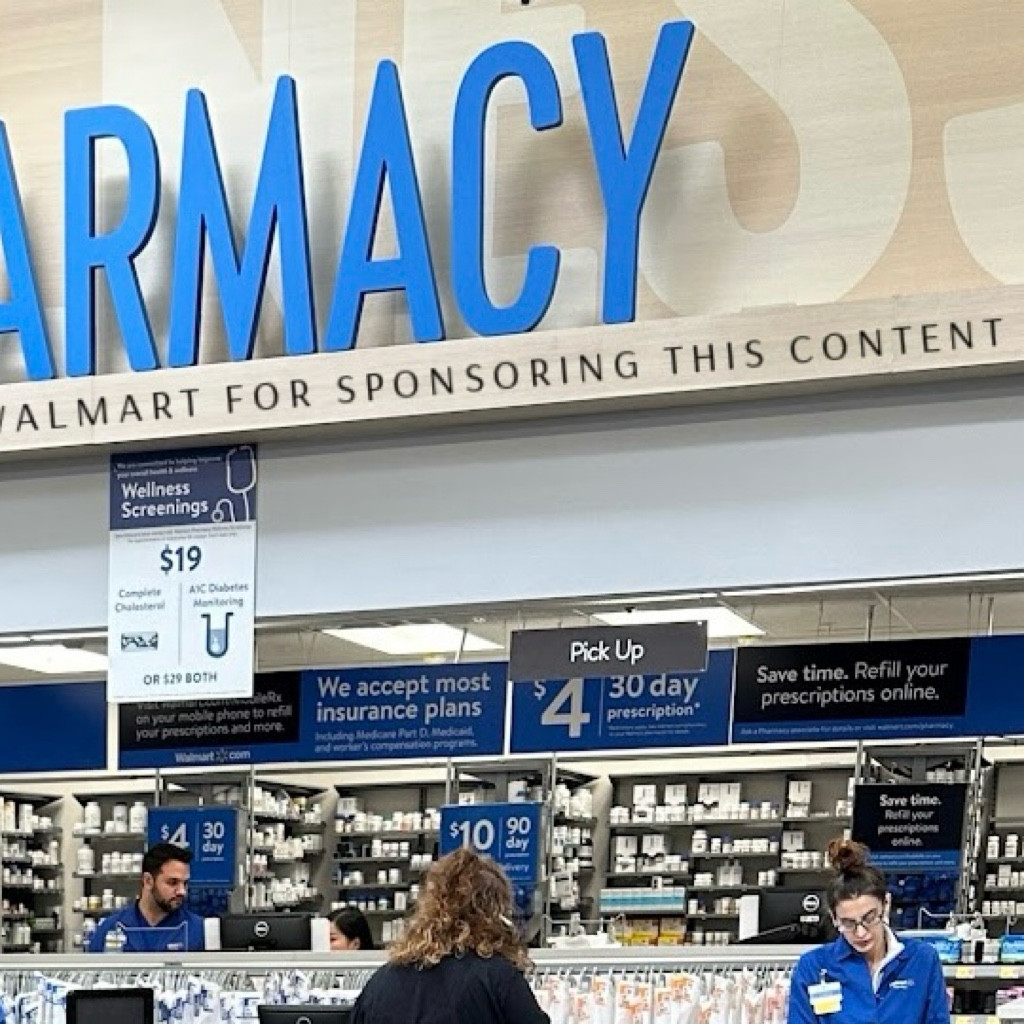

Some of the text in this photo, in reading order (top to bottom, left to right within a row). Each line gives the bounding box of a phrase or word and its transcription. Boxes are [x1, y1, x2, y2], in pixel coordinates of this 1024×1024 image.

[121, 481, 191, 499] Wellness
[121, 498, 209, 519] Screenings
[160, 544, 202, 575] $19
[119, 589, 161, 599] Complete
[208, 582, 249, 593] Diabetes
[115, 601, 166, 612] Cholesterol
[193, 597, 244, 608] Monitoring
[570, 638, 645, 666] Pick Up
[143, 671, 218, 685] OR $29 BOTH
[756, 660, 949, 684] Save time. Refill your
[317, 673, 492, 700] We accept most
[609, 673, 699, 703] 30 day
[761, 683, 940, 710] prescriptions online.
[136, 705, 293, 726] on your mobile phone to refill
[316, 696, 482, 725] insurance plans
[534, 677, 591, 738] $4
[136, 721, 285, 742] your prescriptions and more.
[356, 730, 396, 740] Medicare
[879, 793, 942, 807] Save time.
[885, 809, 934, 822] Refill your
[202, 821, 225, 839] 30
[450, 819, 494, 851] $10
[506, 816, 531, 835] 90
[878, 823, 939, 836] prescriptions
[160, 823, 190, 849] $4
[506, 836, 530, 852] day
[202, 840, 225, 856] day
